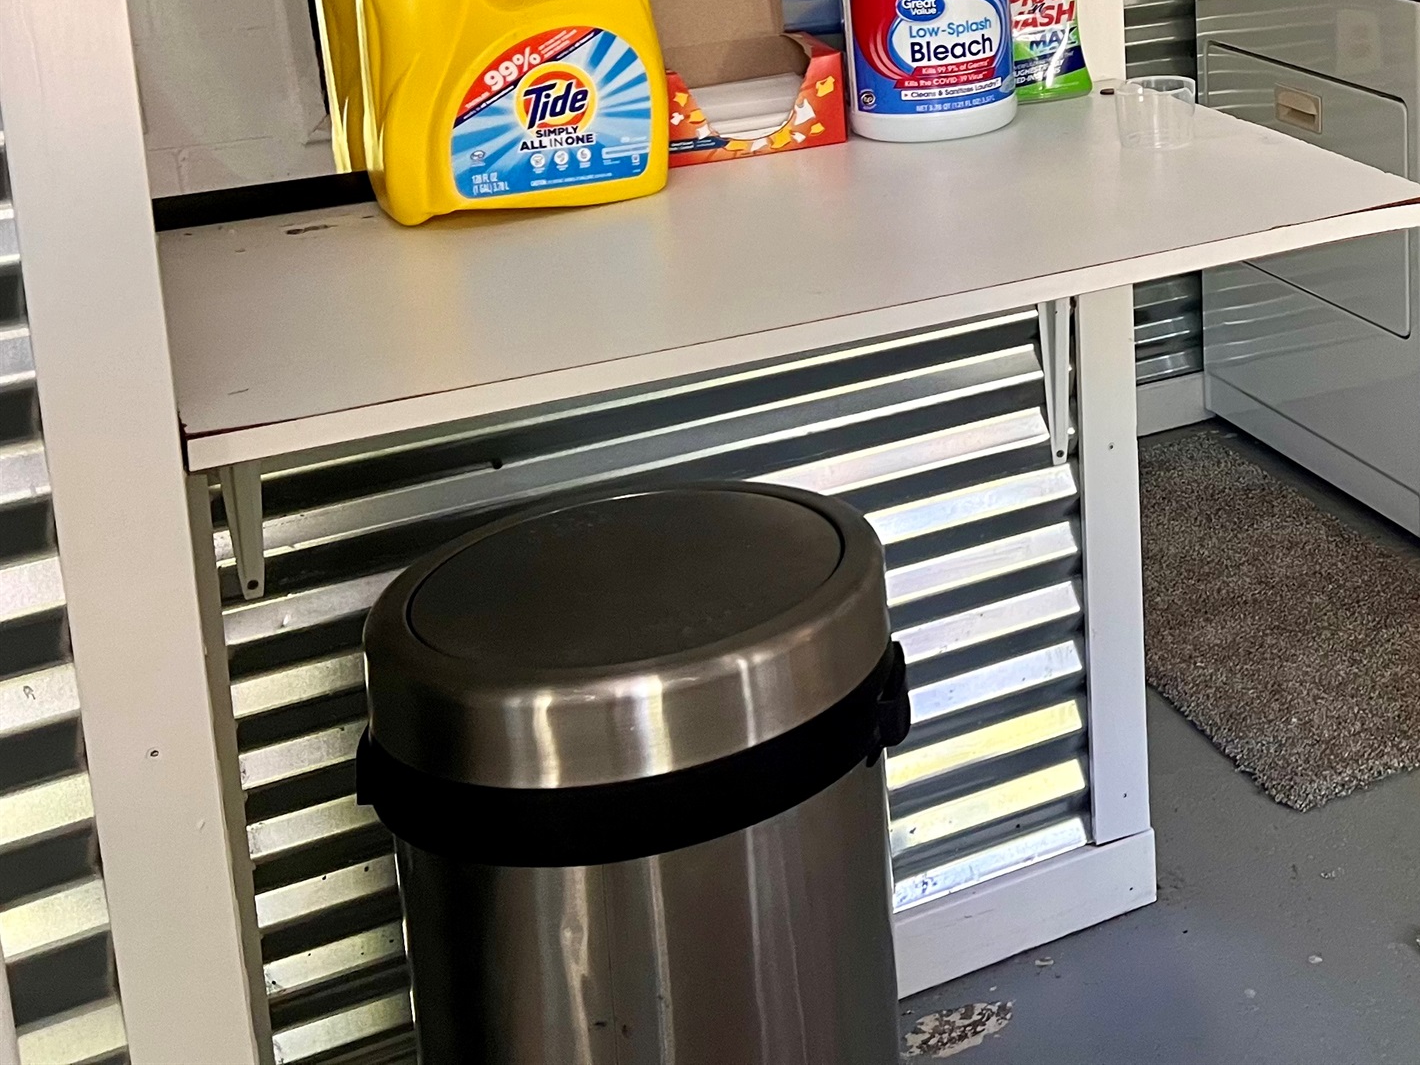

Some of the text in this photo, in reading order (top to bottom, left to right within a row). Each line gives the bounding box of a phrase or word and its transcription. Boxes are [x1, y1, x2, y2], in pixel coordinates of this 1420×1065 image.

[911, 8, 937, 16] Value
[908, 17, 992, 38] Low-Splash
[910, 33, 993, 63] Bleach
[484, 46, 541, 93] 99%
[922, 67, 937, 75] Kills
[937, 64, 958, 74] 99.9%
[959, 62, 967, 71] of
[919, 79, 932, 87] the
[910, 91, 937, 99] Cleans
[945, 87, 974, 97] Sanitizes
[522, 79, 590, 131] Tide
[916, 104, 928, 112] NET
[536, 125, 579, 138] SIMPLY
[520, 133, 595, 152] ALL IN ONE
